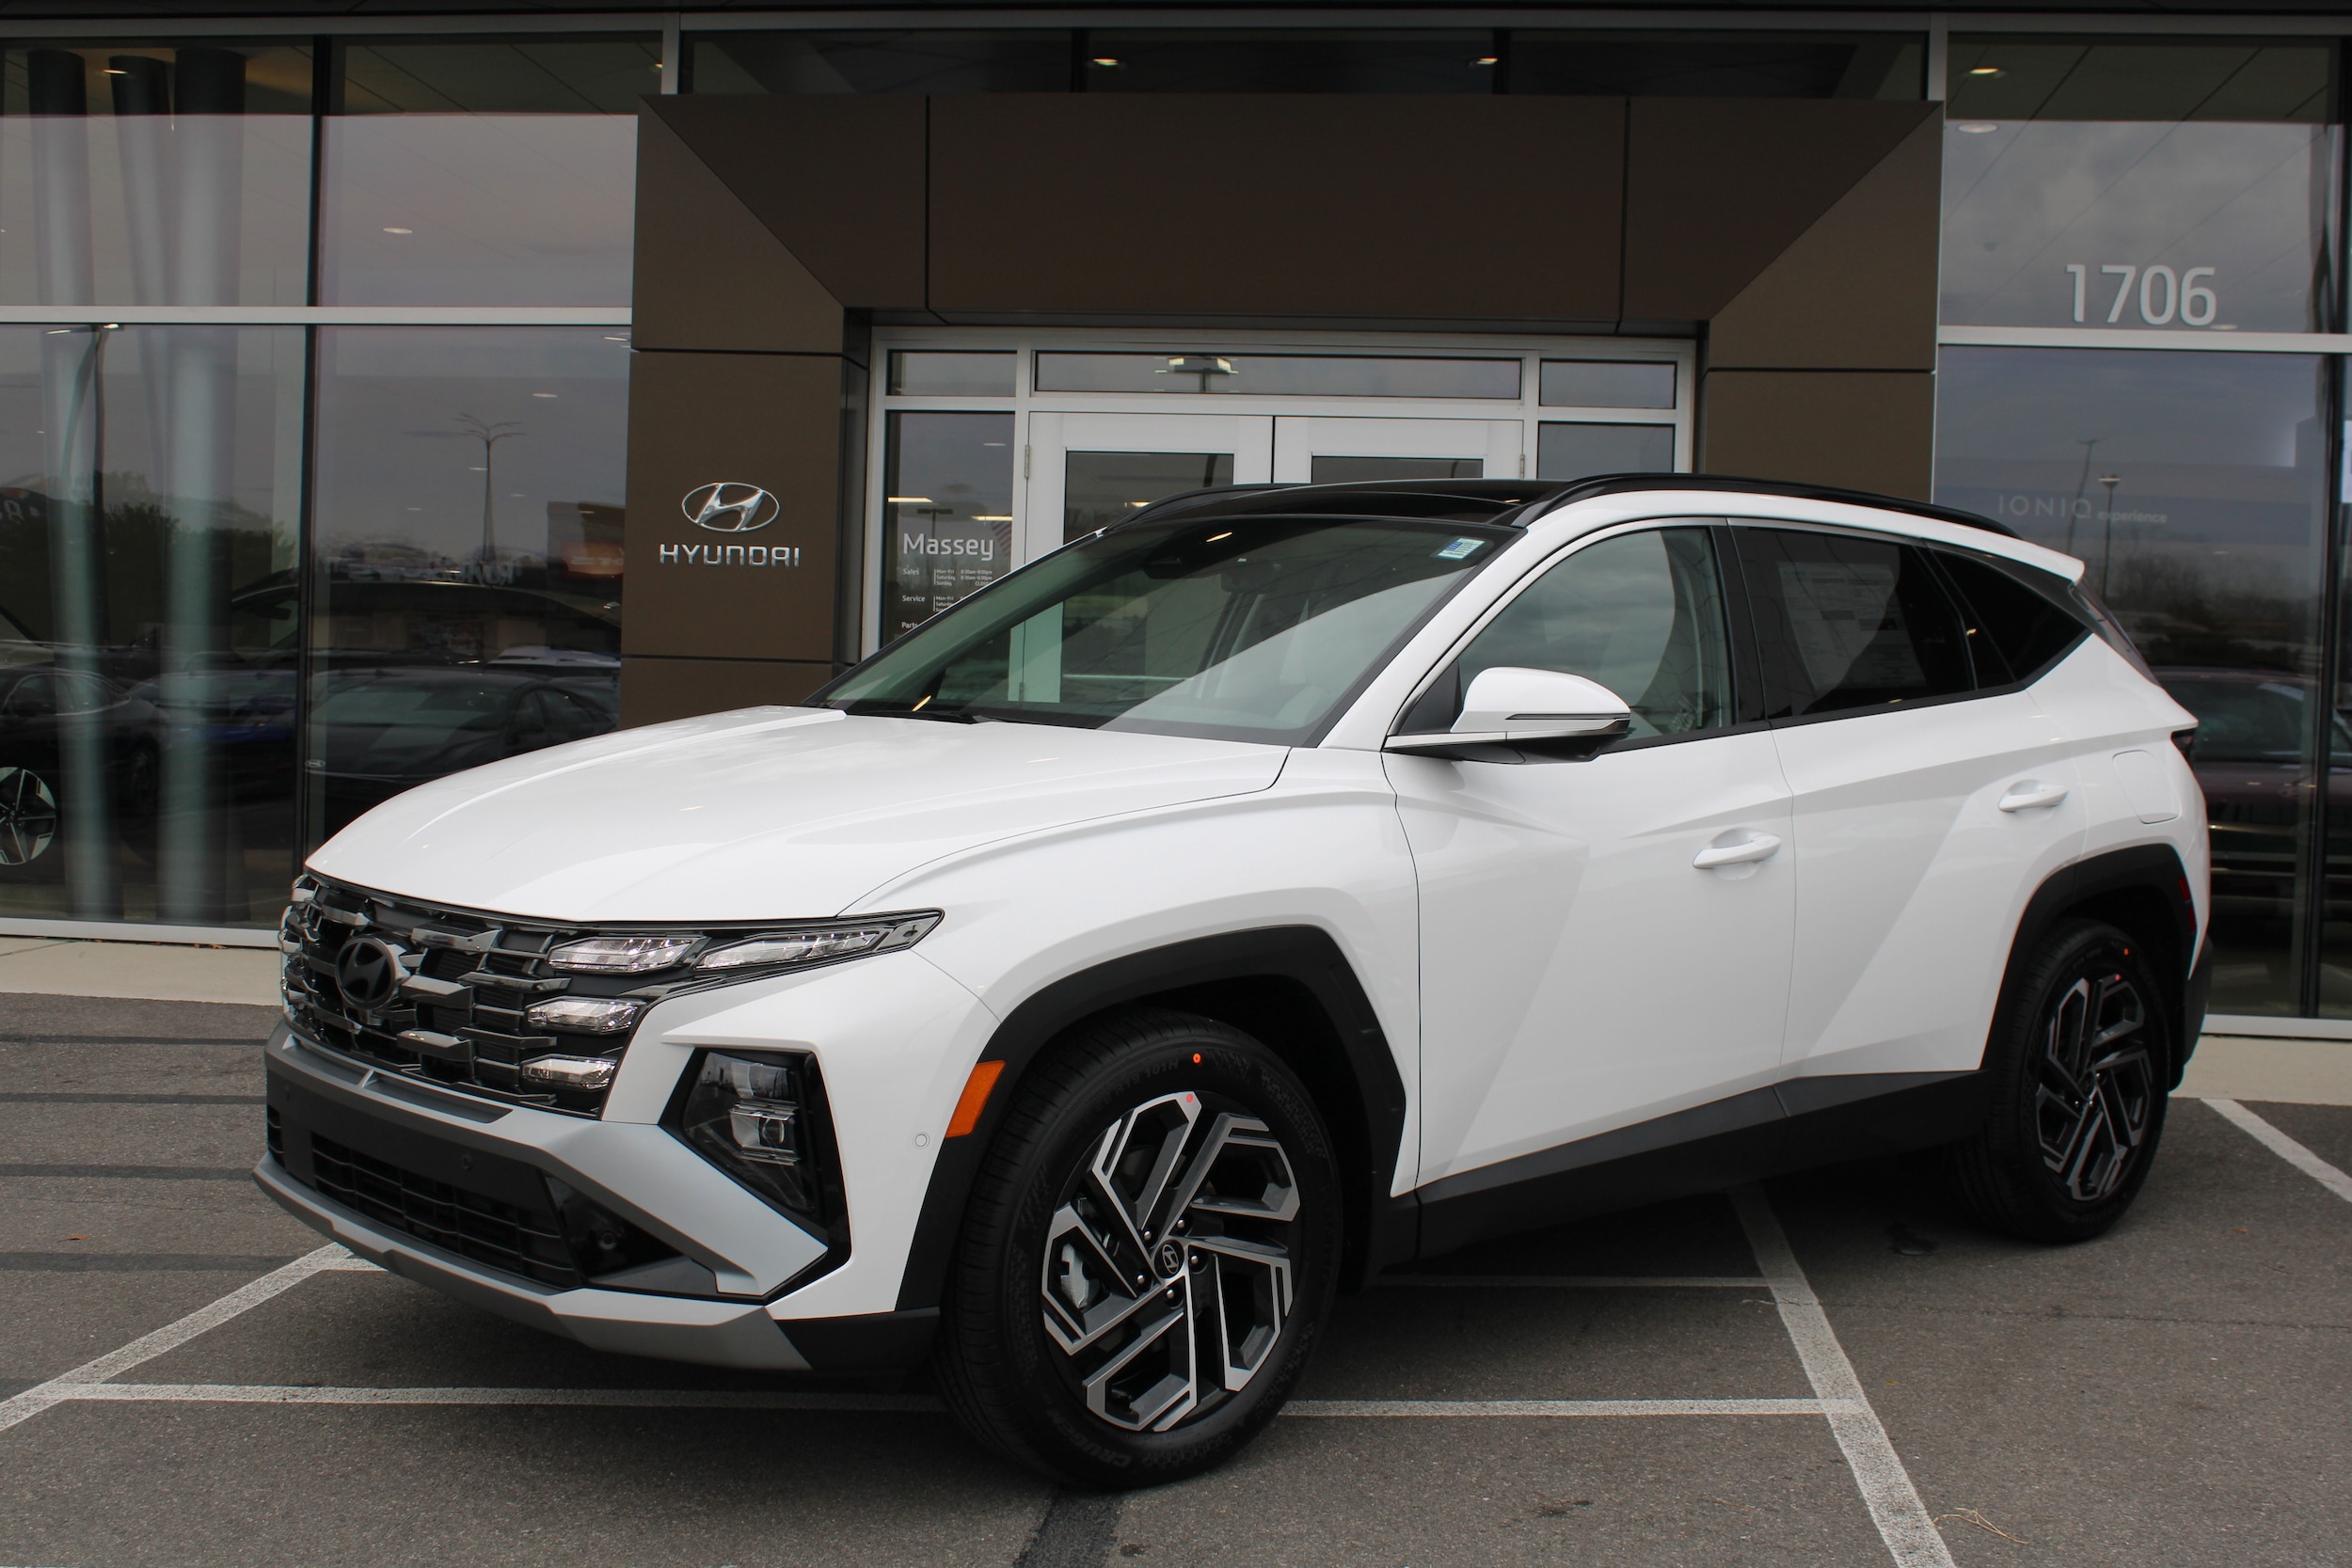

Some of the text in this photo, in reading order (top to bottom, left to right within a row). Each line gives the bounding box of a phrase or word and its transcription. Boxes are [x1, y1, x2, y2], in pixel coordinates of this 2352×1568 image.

[2066, 263, 2217, 326] 1706
[1998, 494, 2091, 519] IONIQ
[660, 544, 800, 568] HYUNDAI
[903, 533, 993, 562] Massey
